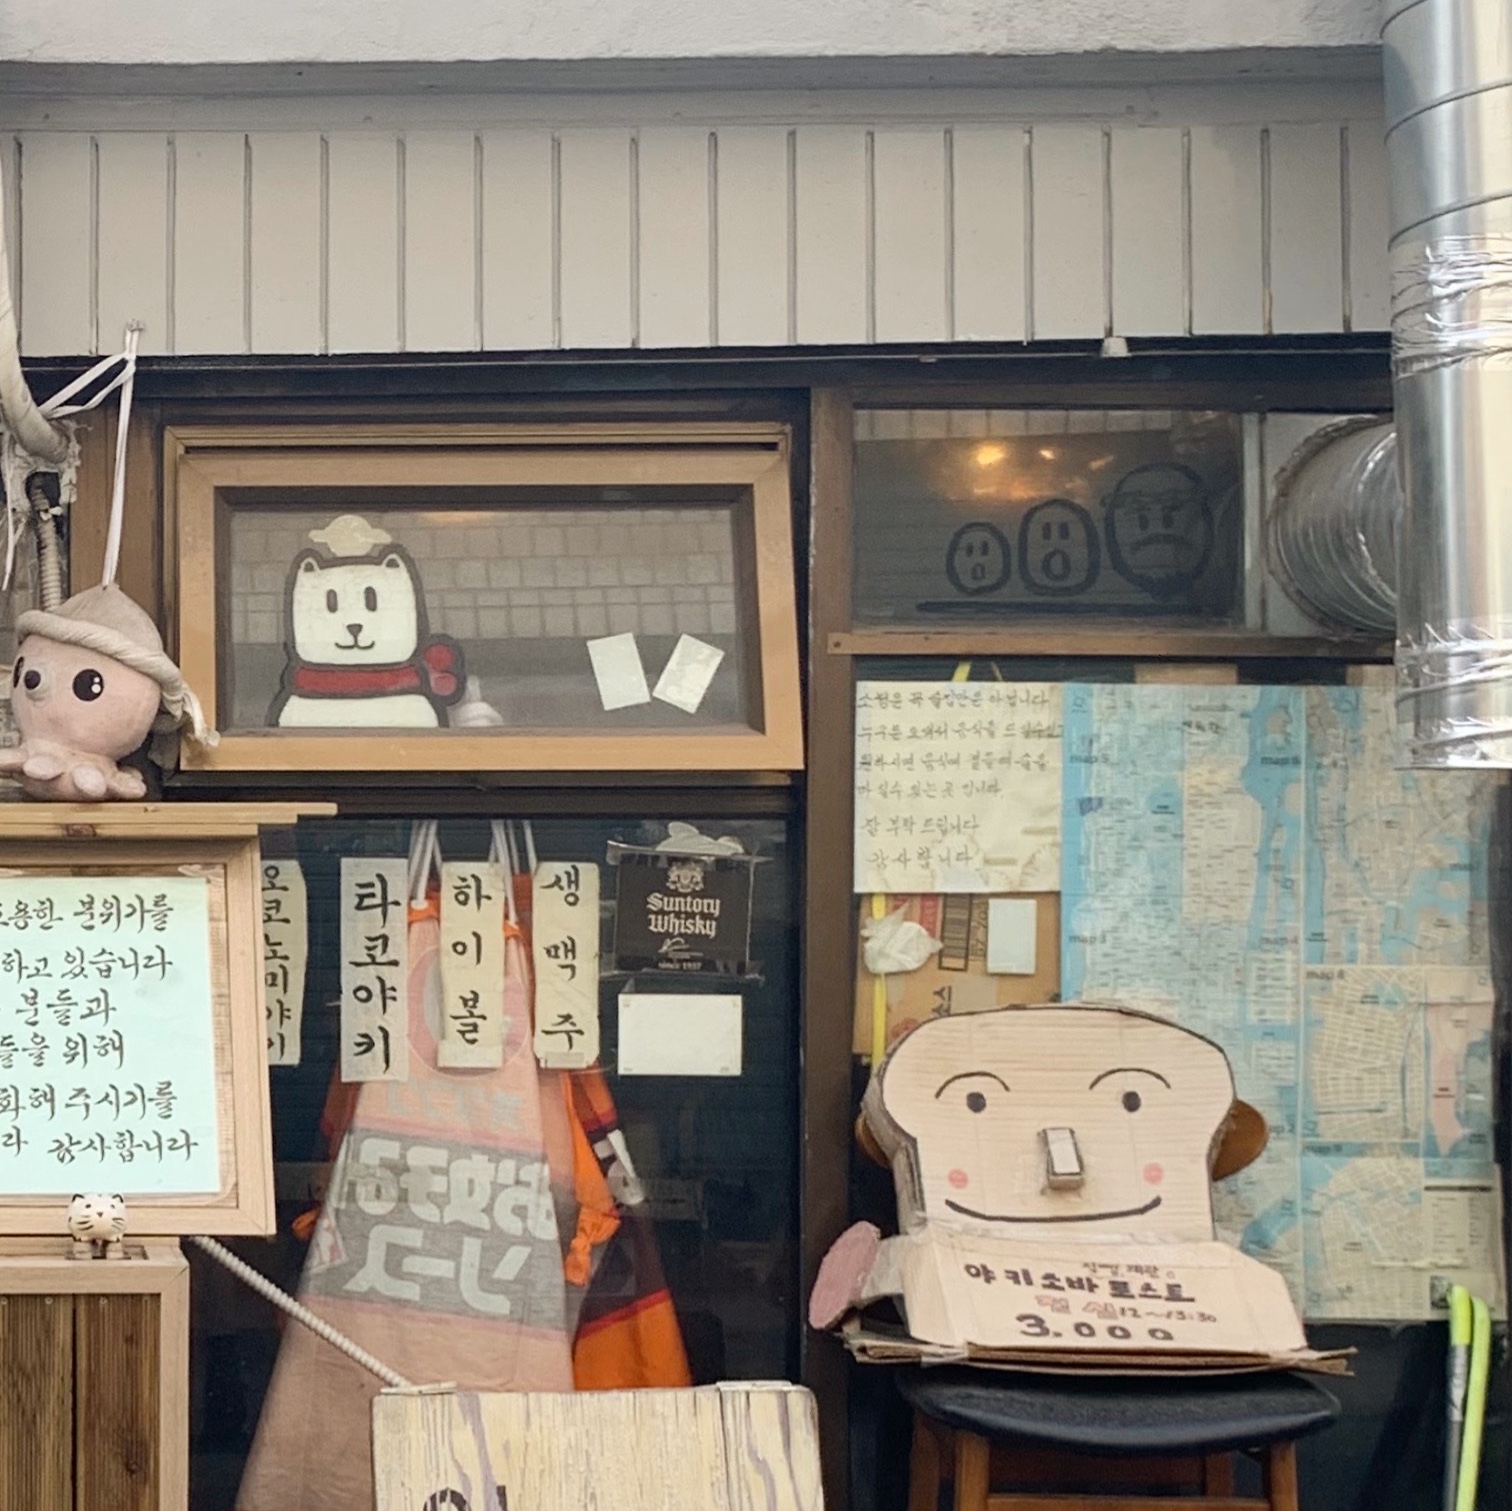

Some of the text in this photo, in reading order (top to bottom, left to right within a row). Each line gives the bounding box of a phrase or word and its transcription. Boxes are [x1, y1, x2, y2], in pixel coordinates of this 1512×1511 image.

[73, 893, 175, 936] 분위기를
[647, 892, 721, 918] Suntory
[648, 913, 716, 939] Whisky
[59, 944, 173, 982] 있습니다
[349, 872, 402, 1074] 타코야키
[450, 874, 492, 1046] 하이볼
[539, 864, 585, 1052] 생맥주
[14, 987, 117, 1028] 분들과
[61, 1028, 126, 1069] 위해
[65, 1079, 178, 1121] 주시기를
[46, 1127, 201, 1167] 감사합니다
